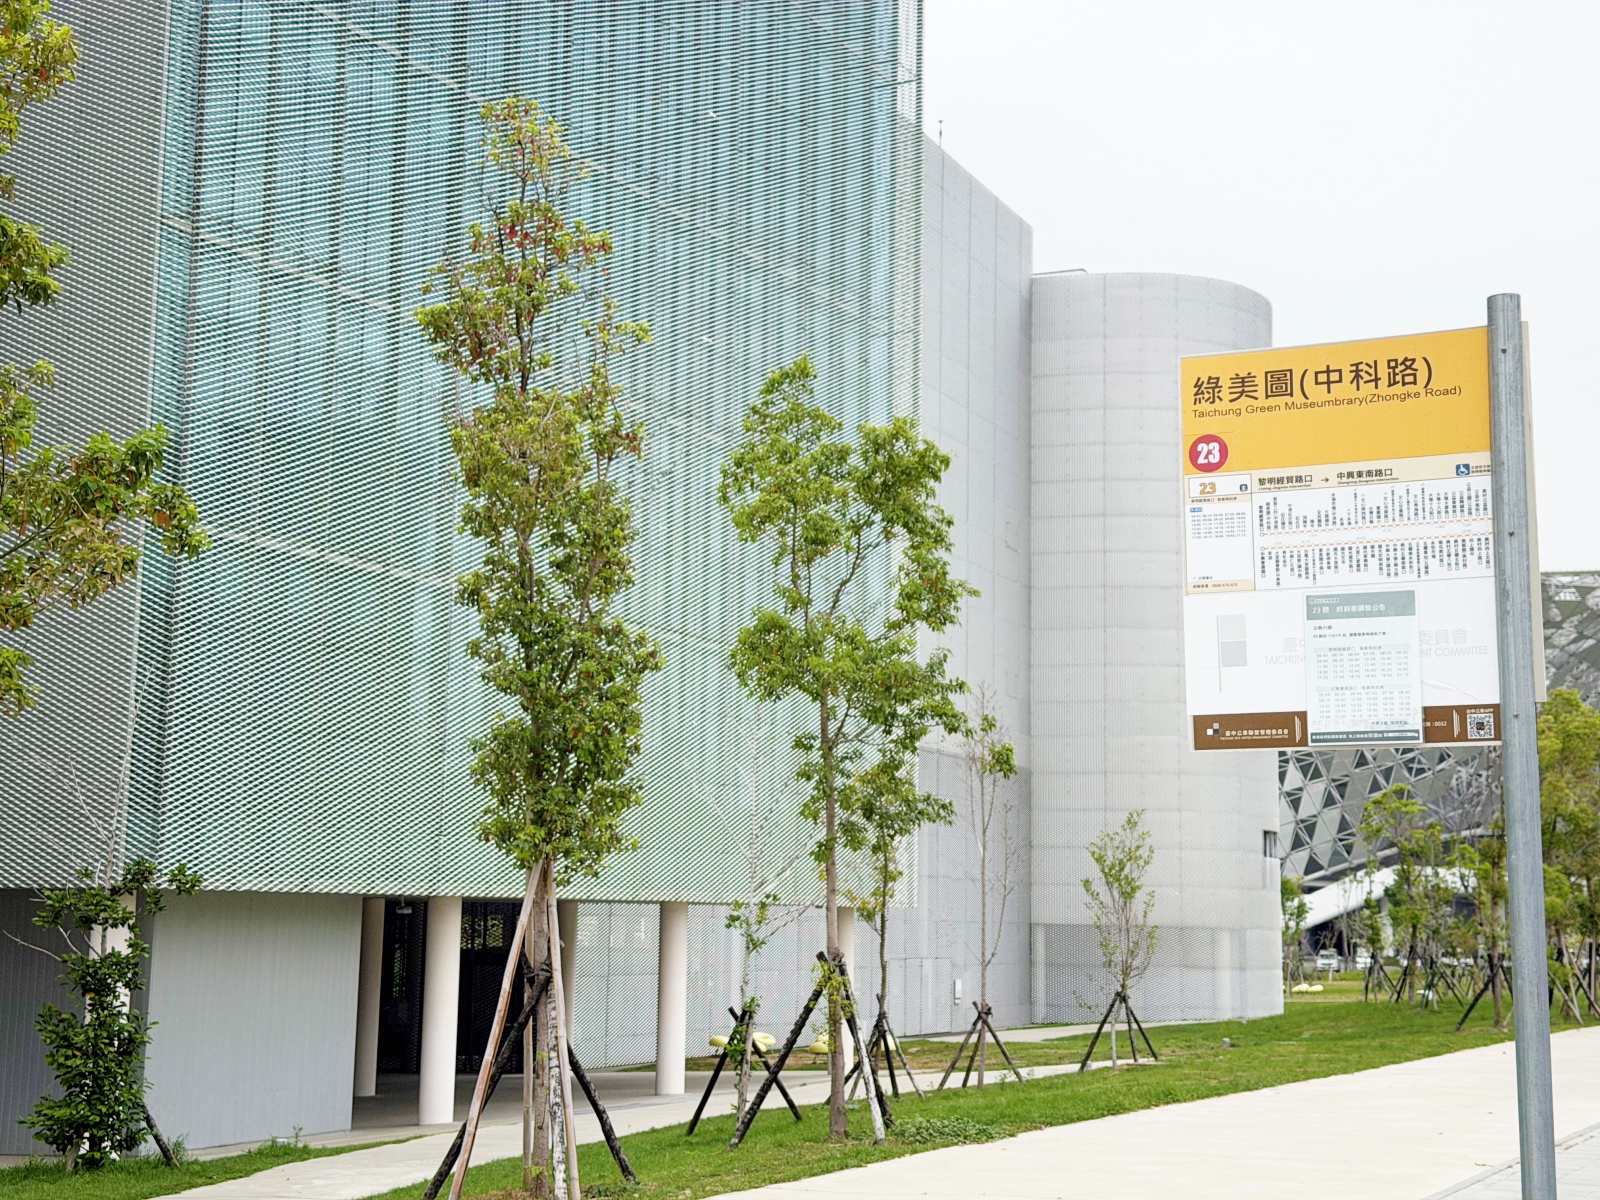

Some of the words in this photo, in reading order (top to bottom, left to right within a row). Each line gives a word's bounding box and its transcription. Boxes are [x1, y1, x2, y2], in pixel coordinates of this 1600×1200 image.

[1192, 356, 1432, 405] 綠美圖(中科路)
[1192, 406, 1242, 418] Taichung
[1245, 404, 1281, 414] Green
[1284, 389, 1421, 410] Museumbrary(Zhongke
[1424, 386, 1462, 398] Road)
[1197, 442, 1220, 464] 23
[1258, 475, 1312, 486] 黎明經貿路口
[1337, 469, 1392, 480] 中興東南路口
[1199, 482, 1217, 495] 23
